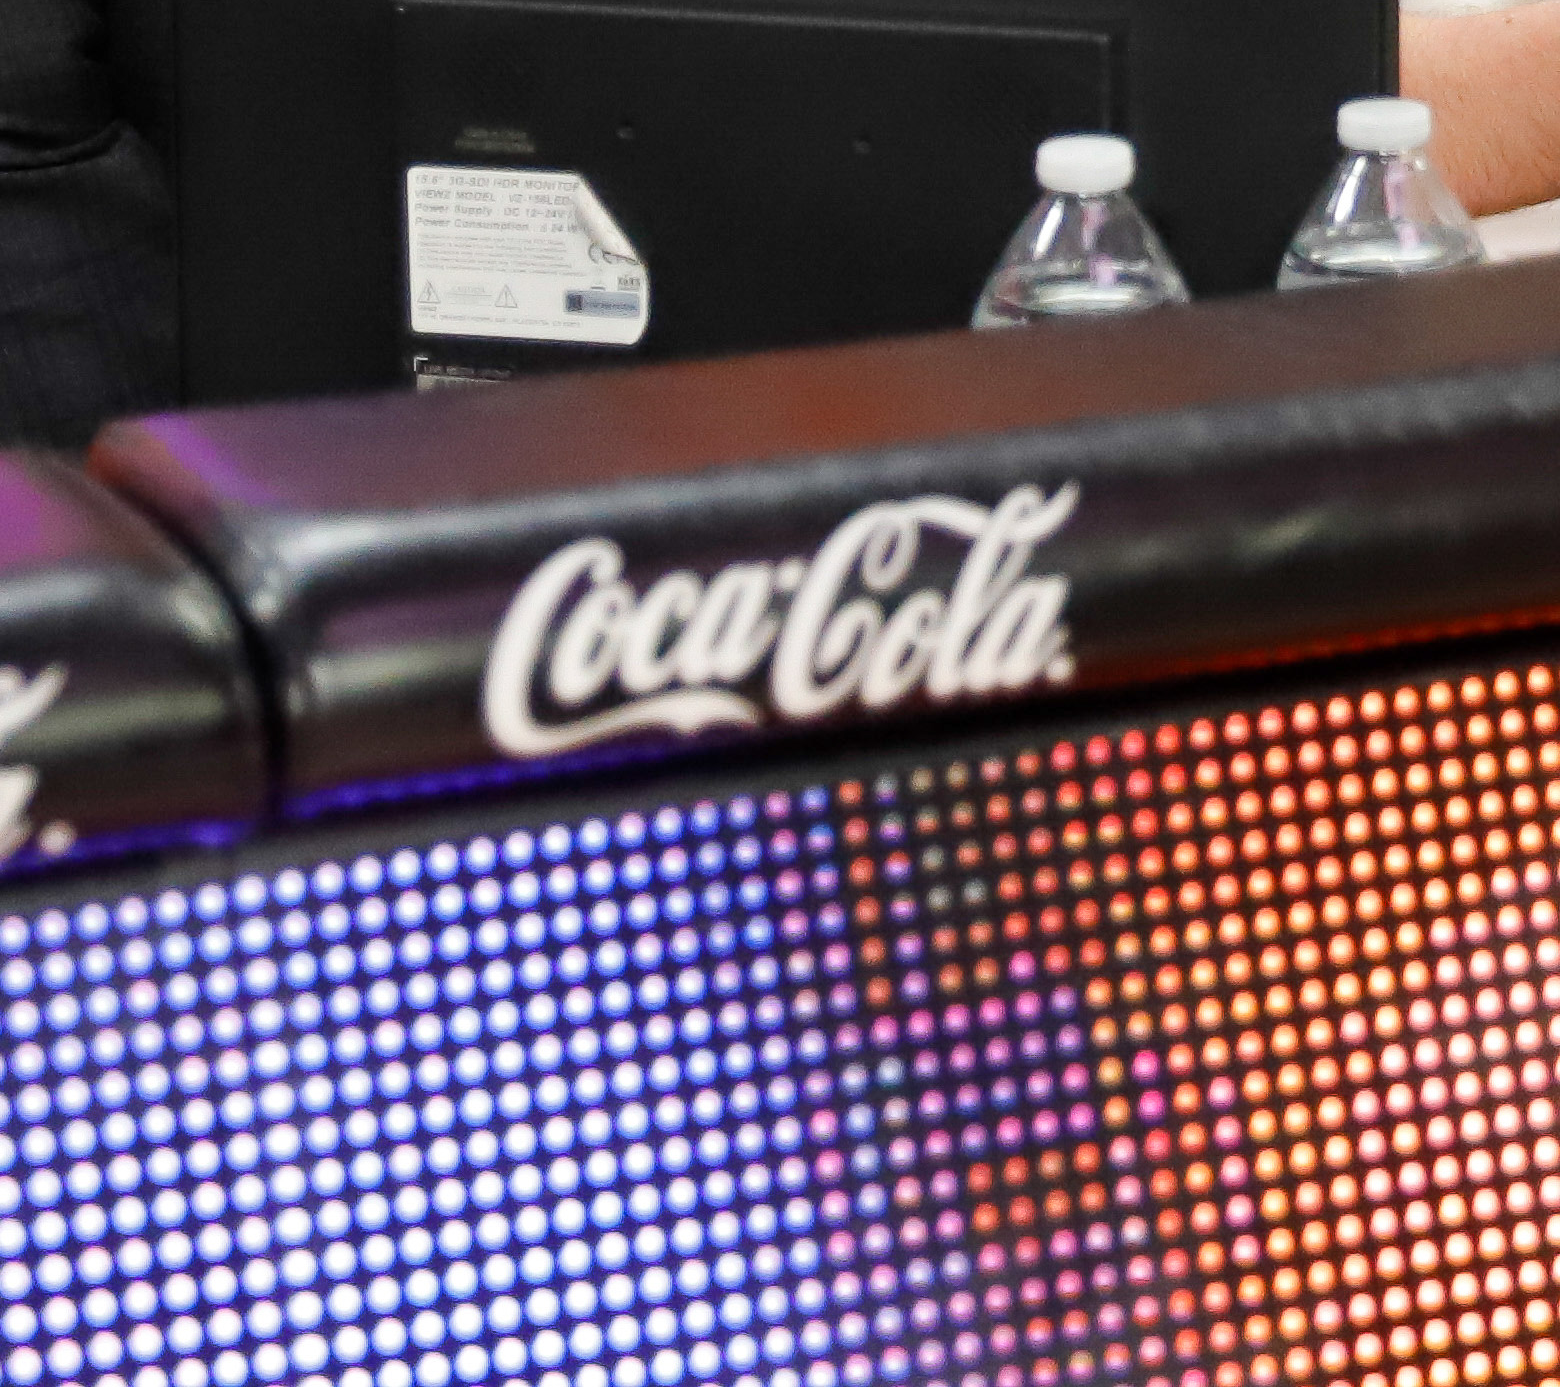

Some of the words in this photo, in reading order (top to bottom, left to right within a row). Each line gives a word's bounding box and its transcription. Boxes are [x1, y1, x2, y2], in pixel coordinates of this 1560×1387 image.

[454, 190, 496, 203] MODEL
[415, 203, 449, 215] Power
[454, 204, 493, 218] Supply
[415, 217, 451, 229] Power
[454, 218, 530, 233] Consumption
[484, 482, 1082, 759] Coca-Cola
